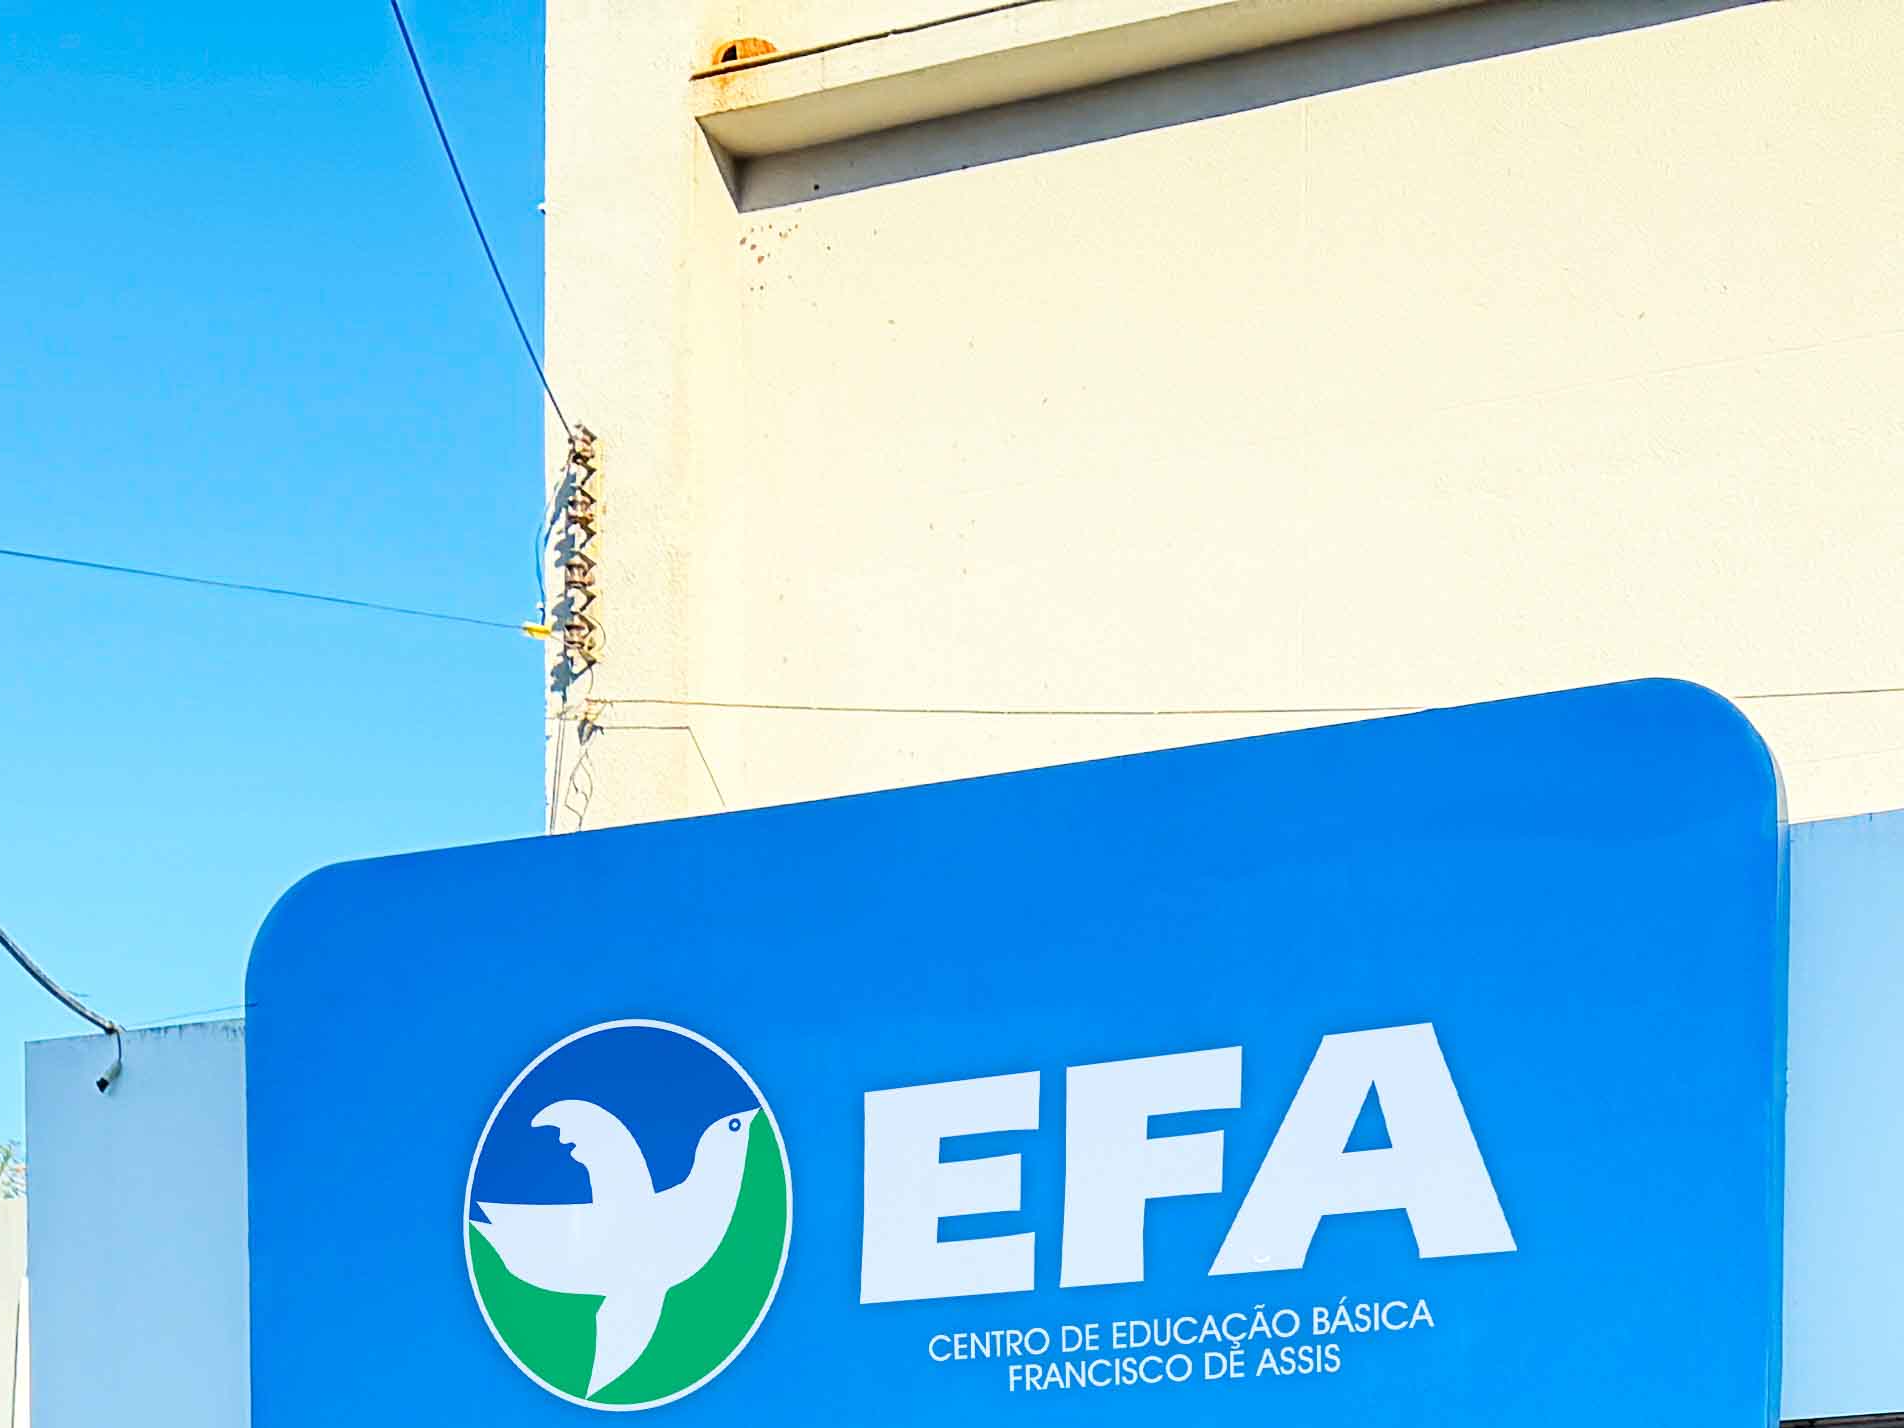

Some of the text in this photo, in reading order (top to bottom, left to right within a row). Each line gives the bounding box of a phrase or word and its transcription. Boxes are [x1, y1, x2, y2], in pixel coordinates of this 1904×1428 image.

[859, 1021, 1519, 1305] EFA
[927, 1296, 1436, 1362] CENTRO DE EDUCAÇÃO BÁSICA
[1008, 1343, 1342, 1392] FRANCISCO DE ASSIS
